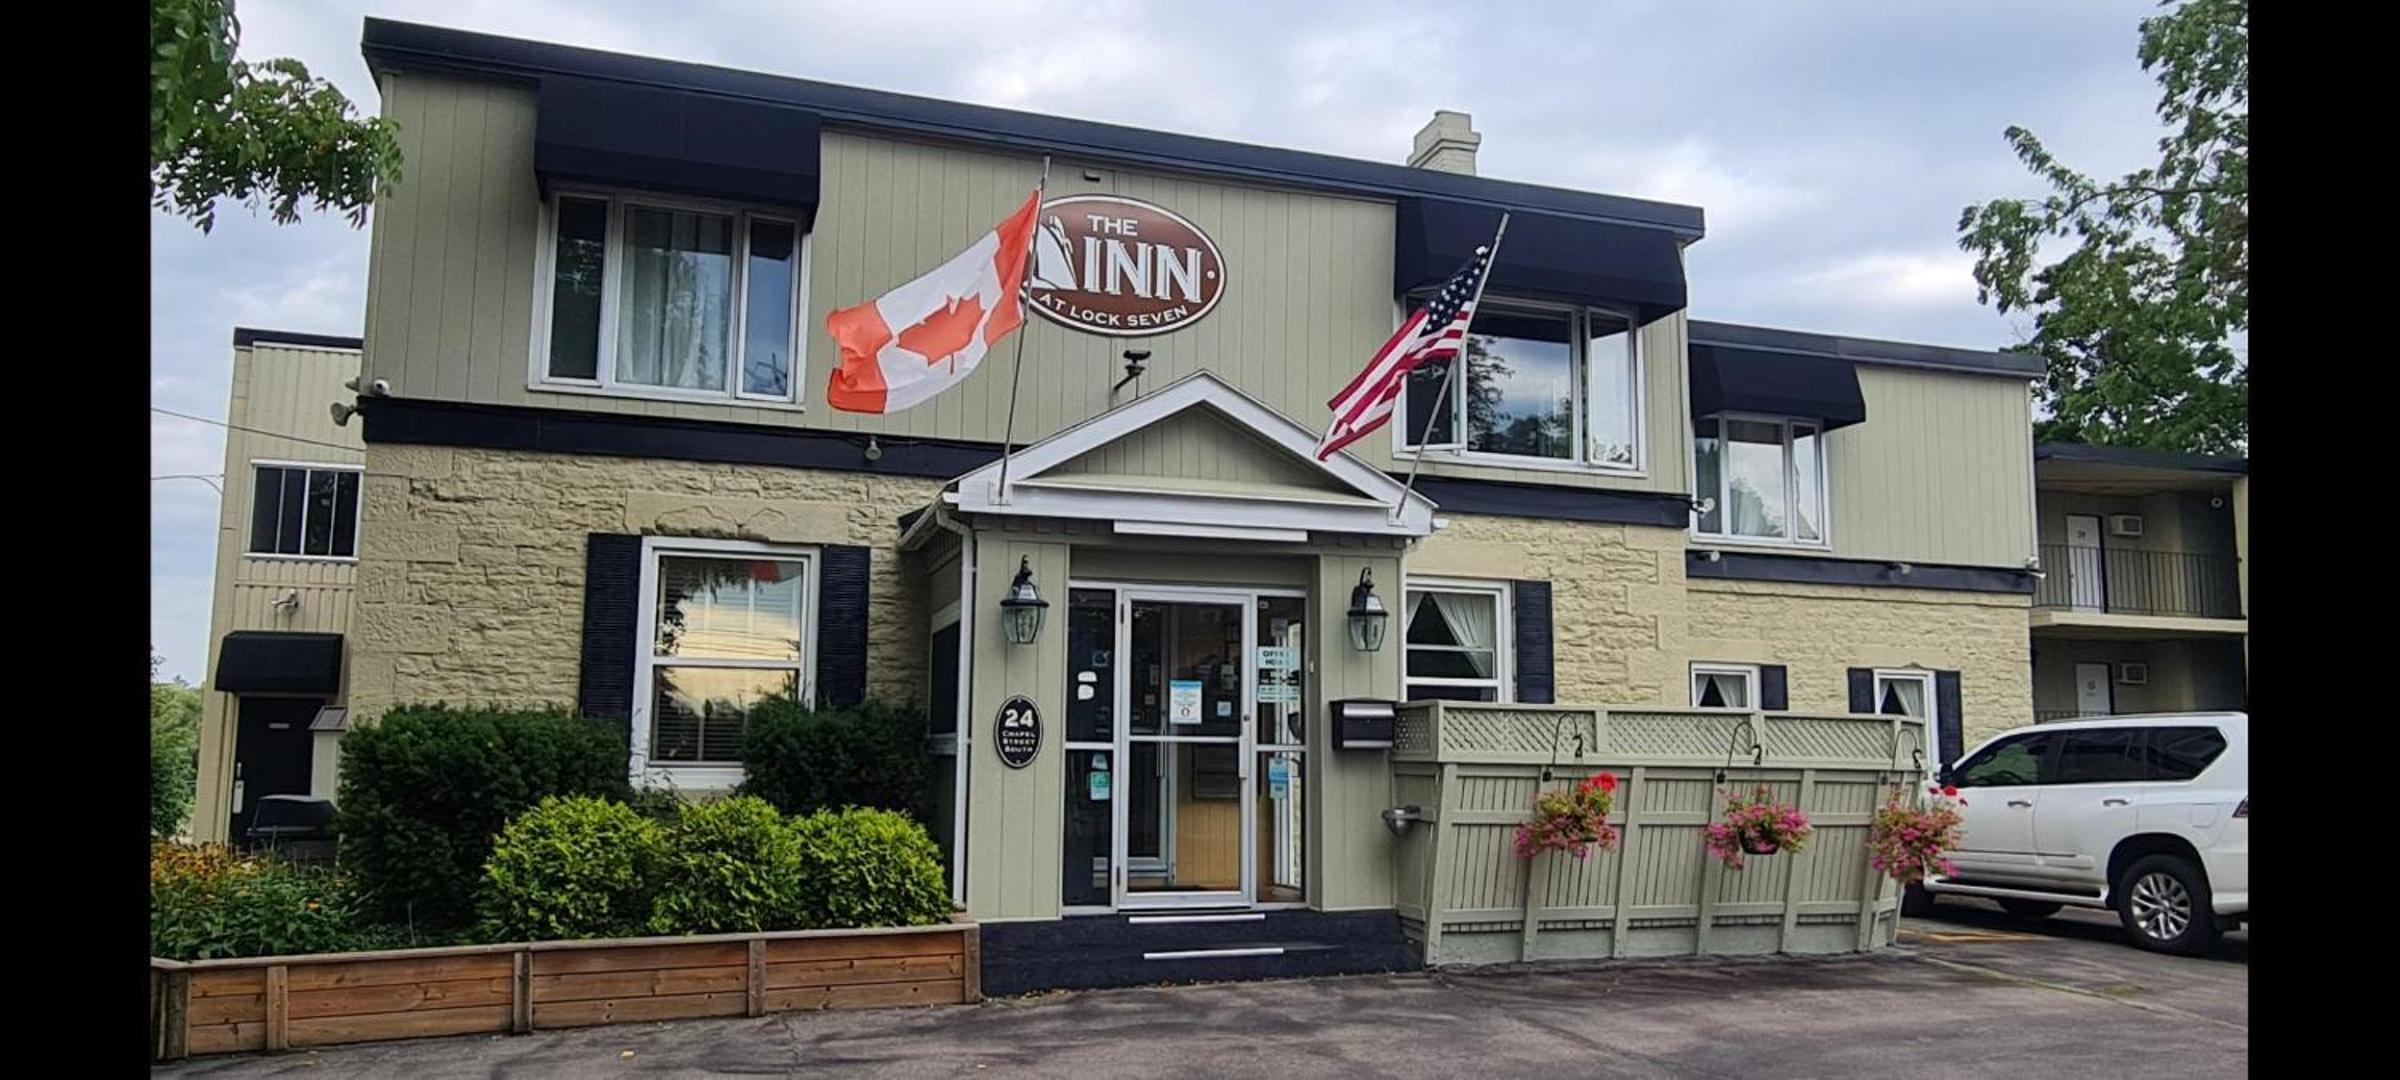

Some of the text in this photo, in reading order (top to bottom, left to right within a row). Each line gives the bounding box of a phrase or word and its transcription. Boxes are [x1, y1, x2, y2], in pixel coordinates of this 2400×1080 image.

[1087, 215, 1138, 236] THE
[1084, 236, 1202, 303] INN
[1038, 293, 1188, 327] AT LOCK SEVEN
[1004, 709, 1034, 727] 24
[1002, 730, 1036, 738] CHAPEL
